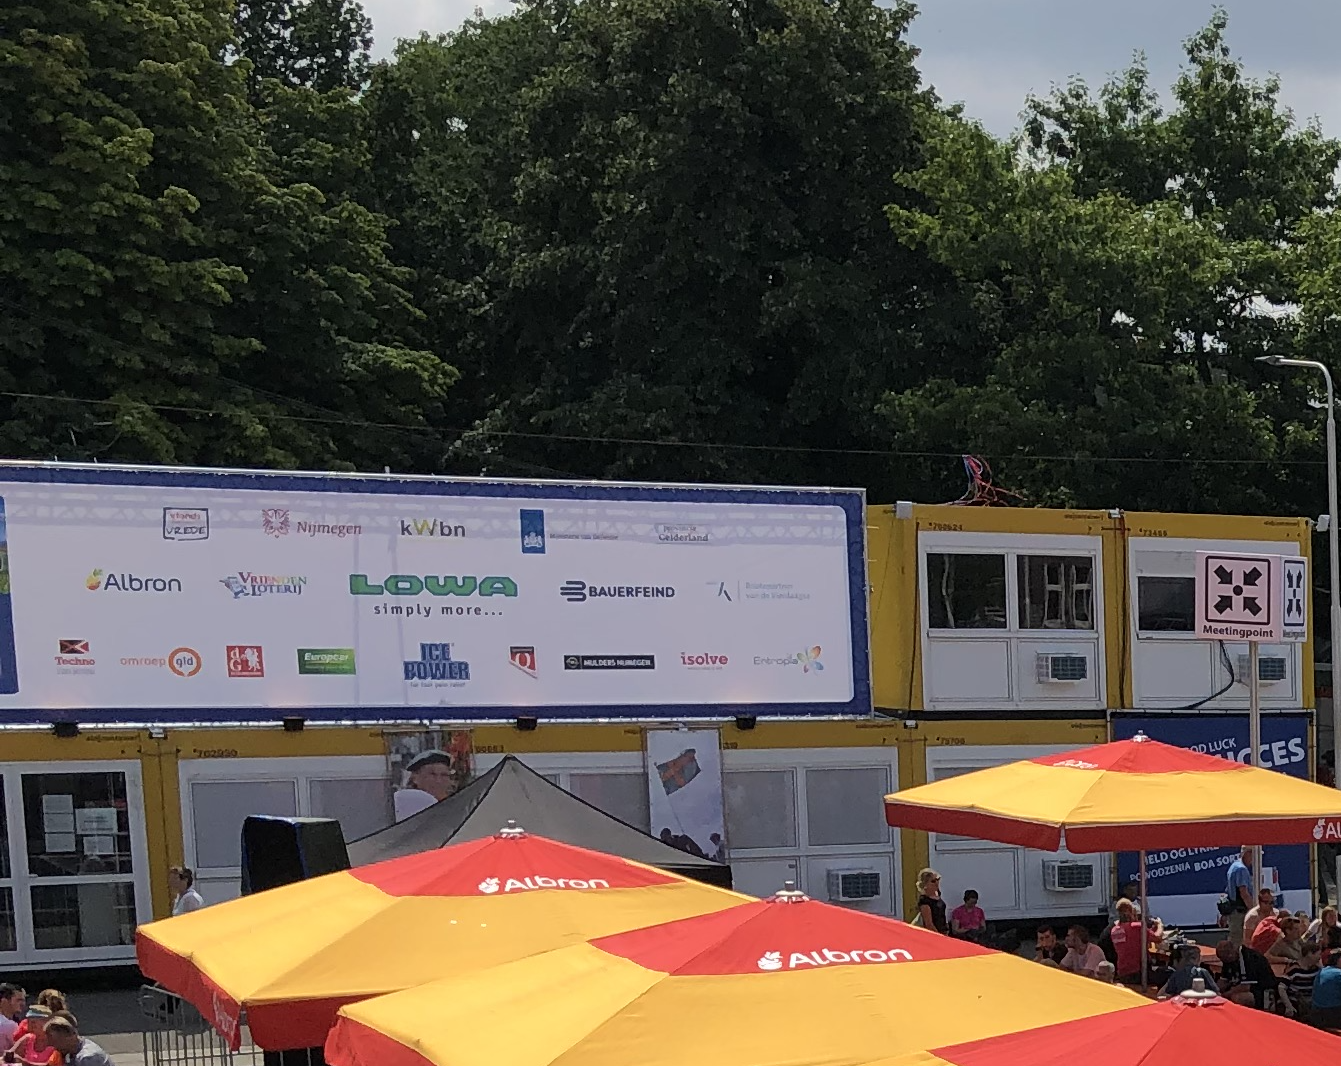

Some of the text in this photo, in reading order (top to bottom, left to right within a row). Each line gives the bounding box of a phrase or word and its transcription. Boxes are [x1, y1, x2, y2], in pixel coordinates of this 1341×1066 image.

[165, 526, 207, 535] VREDE
[296, 520, 362, 538] Nijmegen
[400, 517, 466, 537] kWbn
[658, 533, 709, 542] Gelderland
[104, 573, 182, 593] Albron
[349, 573, 518, 597] LOWA
[588, 586, 675, 598] BAUERFEIND
[373, 602, 503, 618] simply more...
[1202, 625, 1274, 639] Meetingpoint
[304, 652, 349, 664] Europcar
[419, 643, 452, 661] ICE
[680, 651, 729, 666] isolve
[54, 656, 96, 666] Techno
[119, 657, 166, 668] omroep
[403, 661, 471, 681] POWER
[1208, 737, 1237, 753] LUCK
[1170, 849, 1187, 860] OG
[1194, 860, 1216, 872] BOA
[504, 874, 610, 892] Albron
[789, 948, 914, 968] Albron
